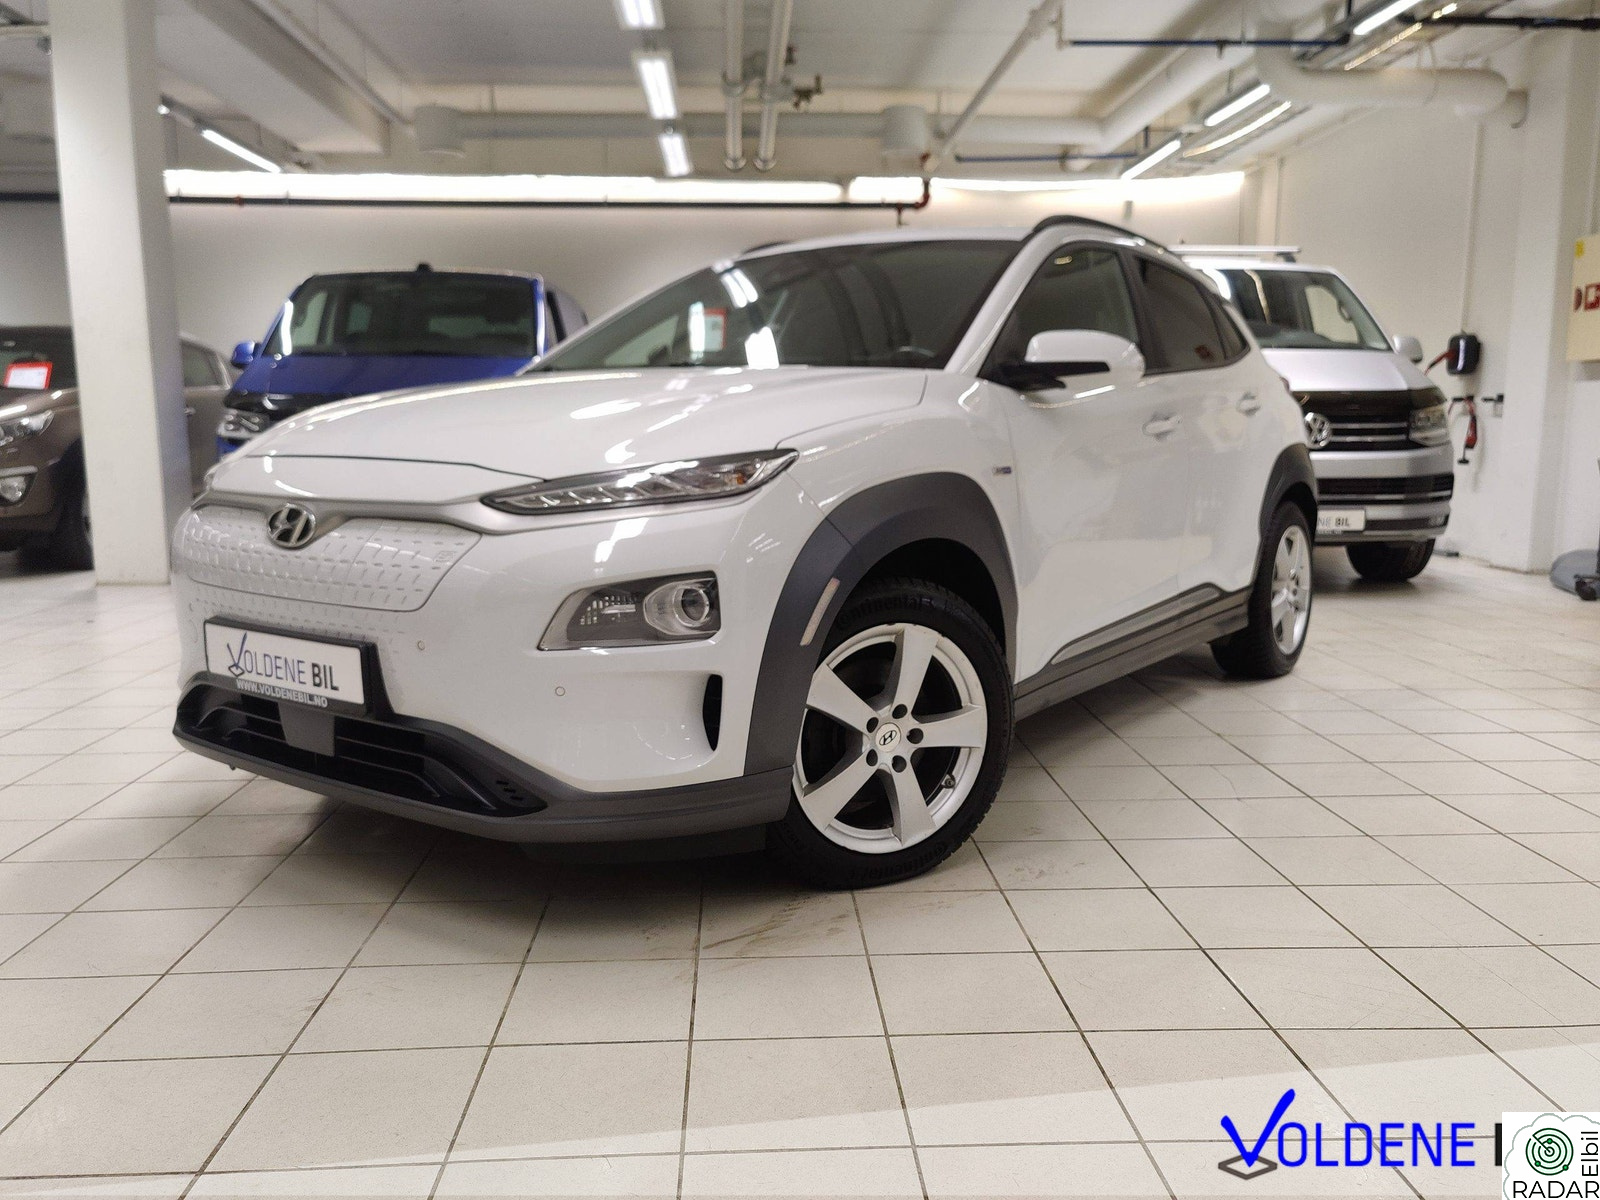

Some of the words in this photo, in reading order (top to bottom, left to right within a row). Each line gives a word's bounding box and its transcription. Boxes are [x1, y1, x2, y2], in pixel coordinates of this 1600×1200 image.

[226, 631, 307, 685] VOLDENE
[311, 662, 339, 691] BIL
[236, 678, 328, 708] WWW.VOLDENEBIL.NO
